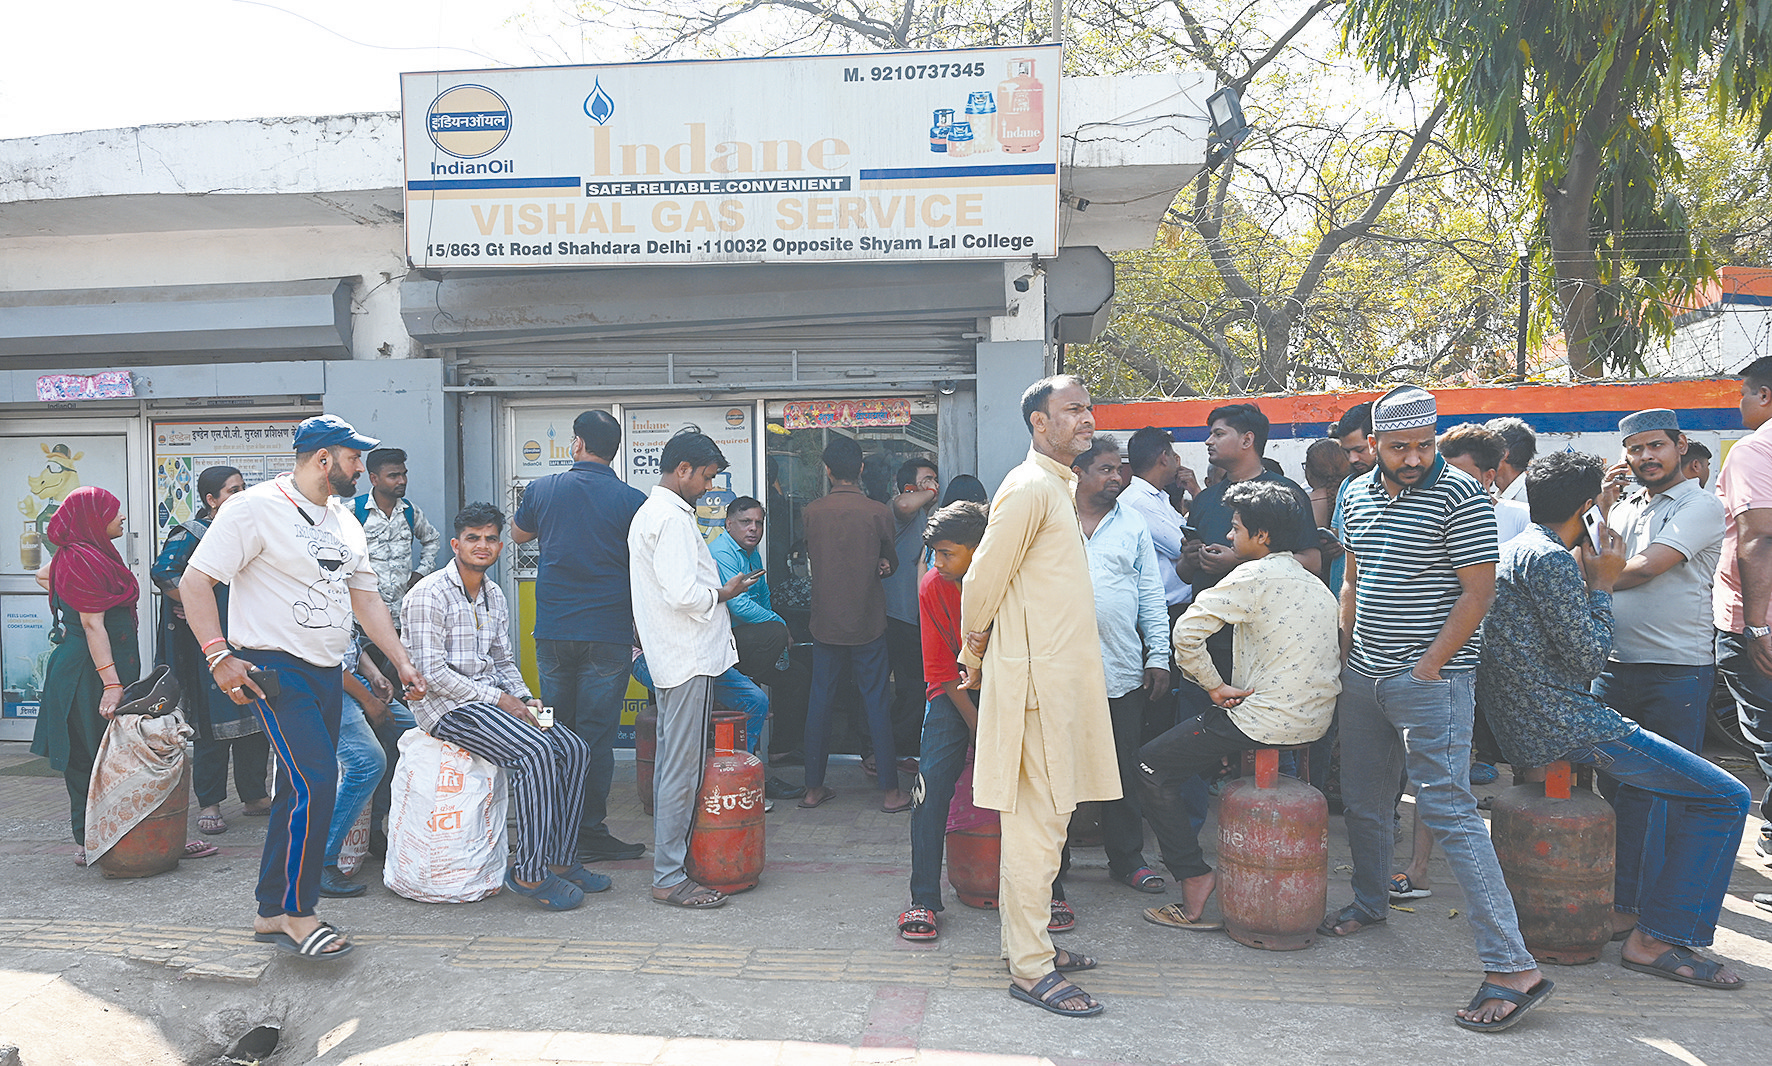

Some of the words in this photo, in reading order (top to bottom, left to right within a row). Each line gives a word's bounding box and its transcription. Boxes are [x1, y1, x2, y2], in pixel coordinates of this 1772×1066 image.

[844, 67, 864, 82] M.
[870, 63, 985, 81] 9210737345
[1002, 126, 1041, 139] Indane
[589, 122, 850, 177] Indane
[430, 160, 514, 175] IndianOil
[588, 178, 843, 196] SAFE.RELIABLE.CONVENIENT
[470, 201, 636, 236] VISHAL
[651, 199, 745, 234] GAS
[776, 194, 983, 231] SERVICE
[427, 243, 480, 258] 15/863
[486, 244, 504, 256] Gt
[510, 242, 552, 256] Road
[558, 241, 641, 255] Shahdara
[647, 240, 691, 254] Delhi
[697, 238, 766, 254] -110032
[772, 237, 854, 255] Opposite
[860, 236, 922, 254] Shyam
[928, 235, 956, 249] Lal
[962, 234, 1034, 251] College
[632, 419, 669, 430] Indane
